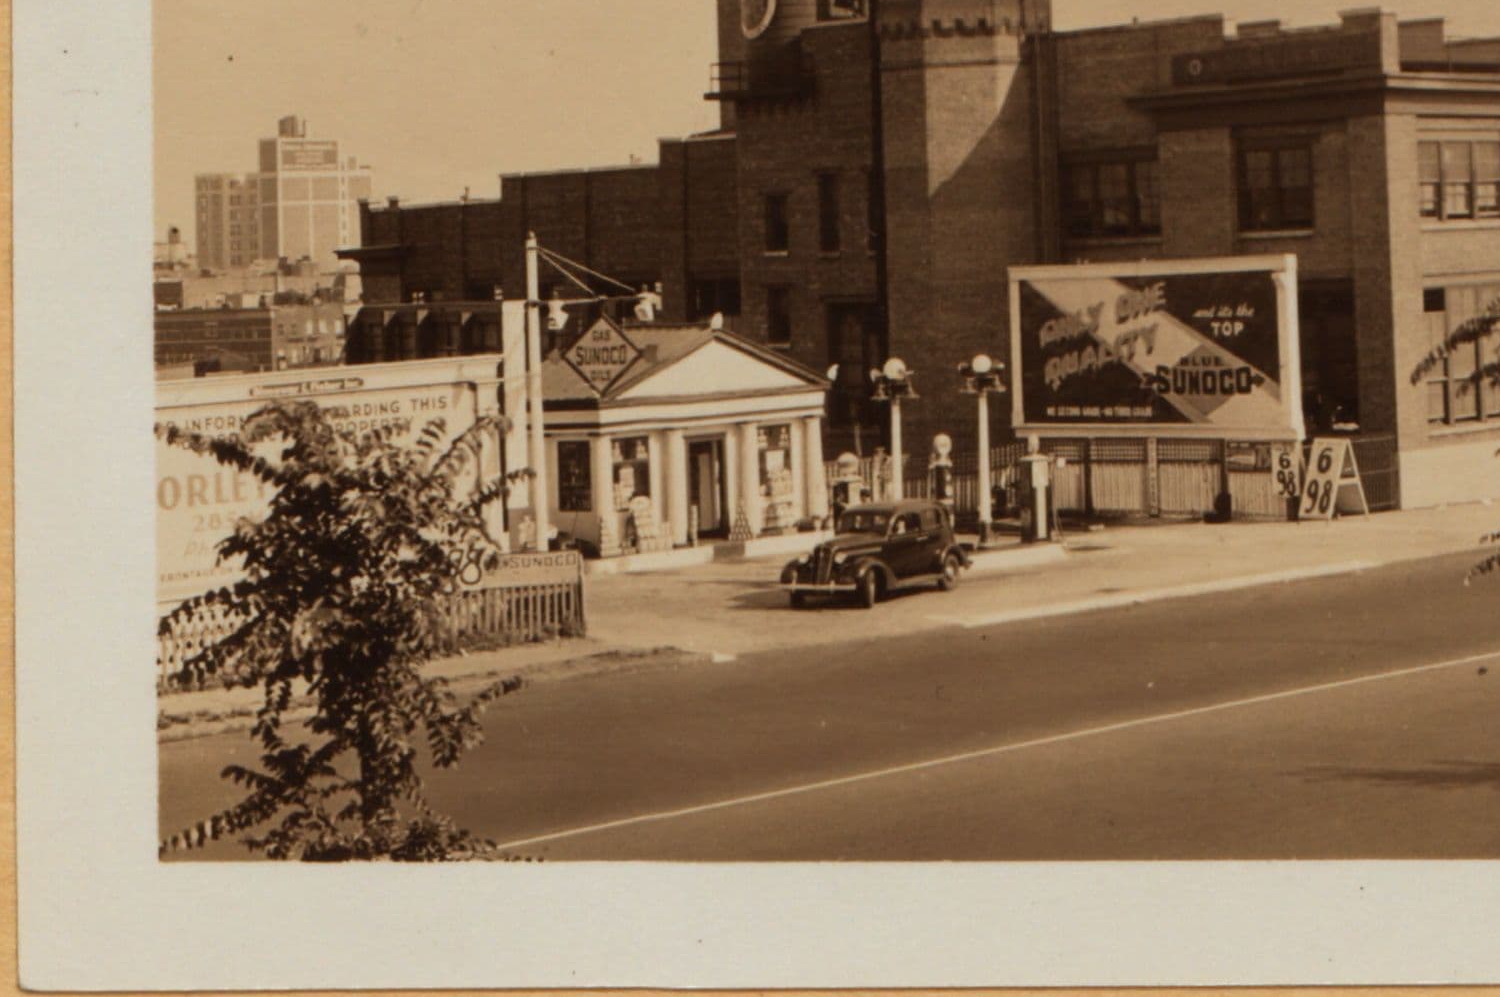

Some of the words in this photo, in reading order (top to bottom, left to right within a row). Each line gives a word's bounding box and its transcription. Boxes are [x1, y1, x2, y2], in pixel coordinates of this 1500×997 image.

[1210, 321, 1244, 337] TOP
[576, 344, 626, 366] SUNOCO
[1156, 365, 1252, 395] SUNOCO
[410, 396, 448, 412] THIS
[1279, 452, 1291, 469] 6
[1317, 447, 1332, 473] 6
[1277, 470, 1296, 497] 98
[1305, 479, 1332, 514] 98
[511, 553, 576, 569] SUNOCO
